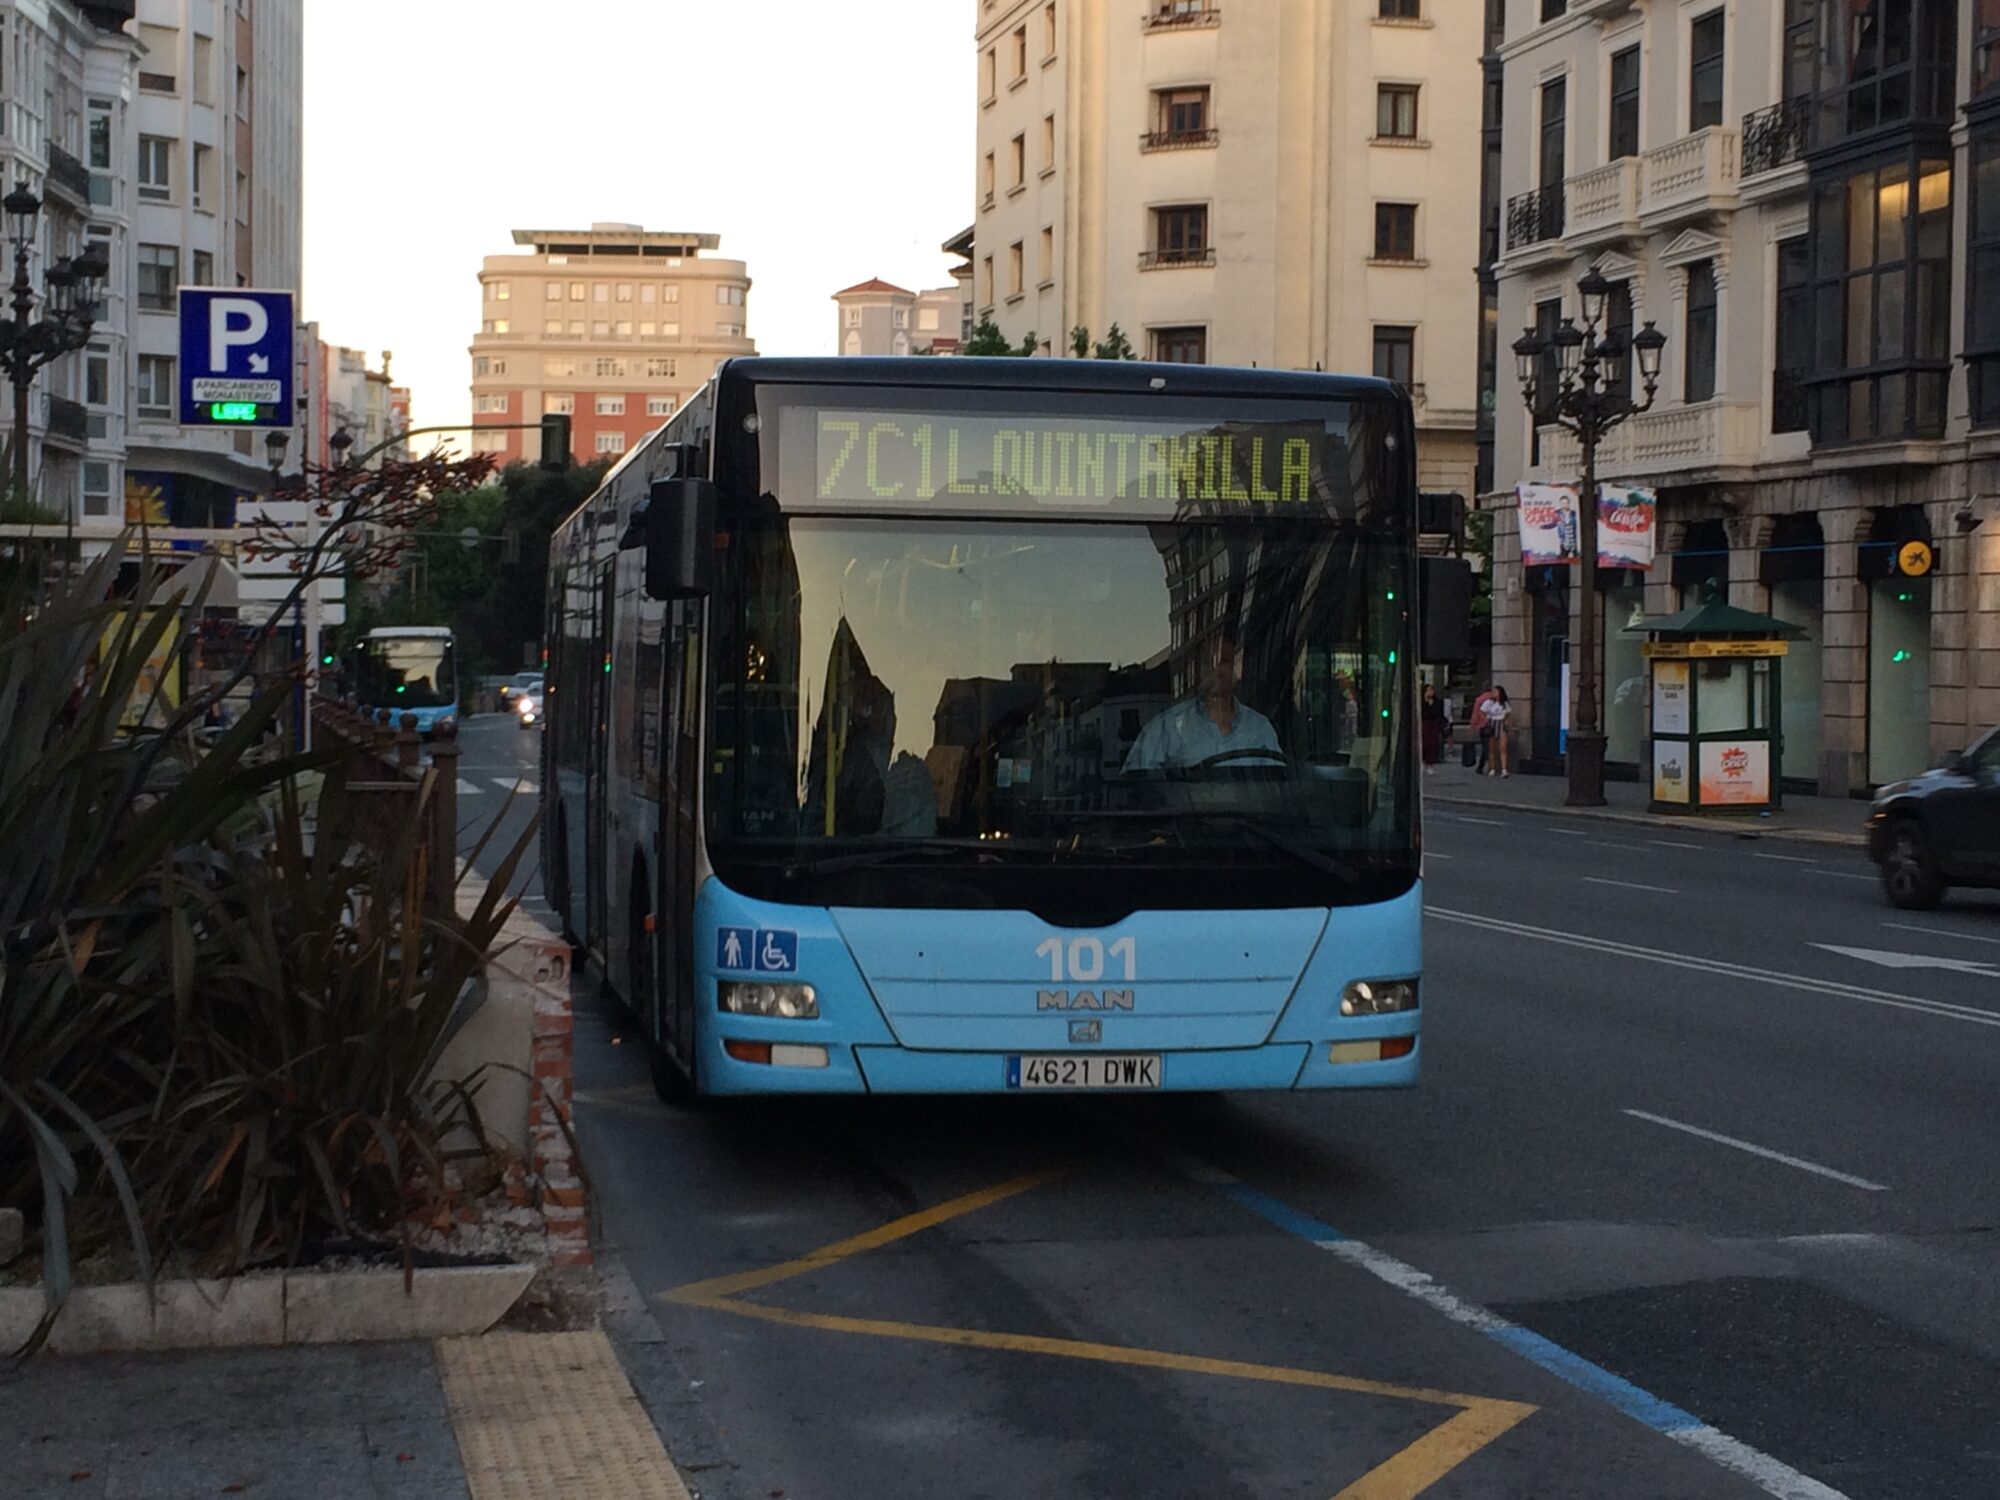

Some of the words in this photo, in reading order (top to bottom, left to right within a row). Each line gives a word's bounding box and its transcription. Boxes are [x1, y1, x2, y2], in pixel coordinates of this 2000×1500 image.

[209, 298, 268, 373] P
[196, 380, 278, 392] APARCAMIENTO
[203, 390, 273, 400] MONASTERIO
[1035, 936, 1136, 981] 101
[1036, 989, 1135, 1011] MAN
[1026, 1059, 1090, 1084] 4621
[1104, 1059, 1155, 1087] DWK
